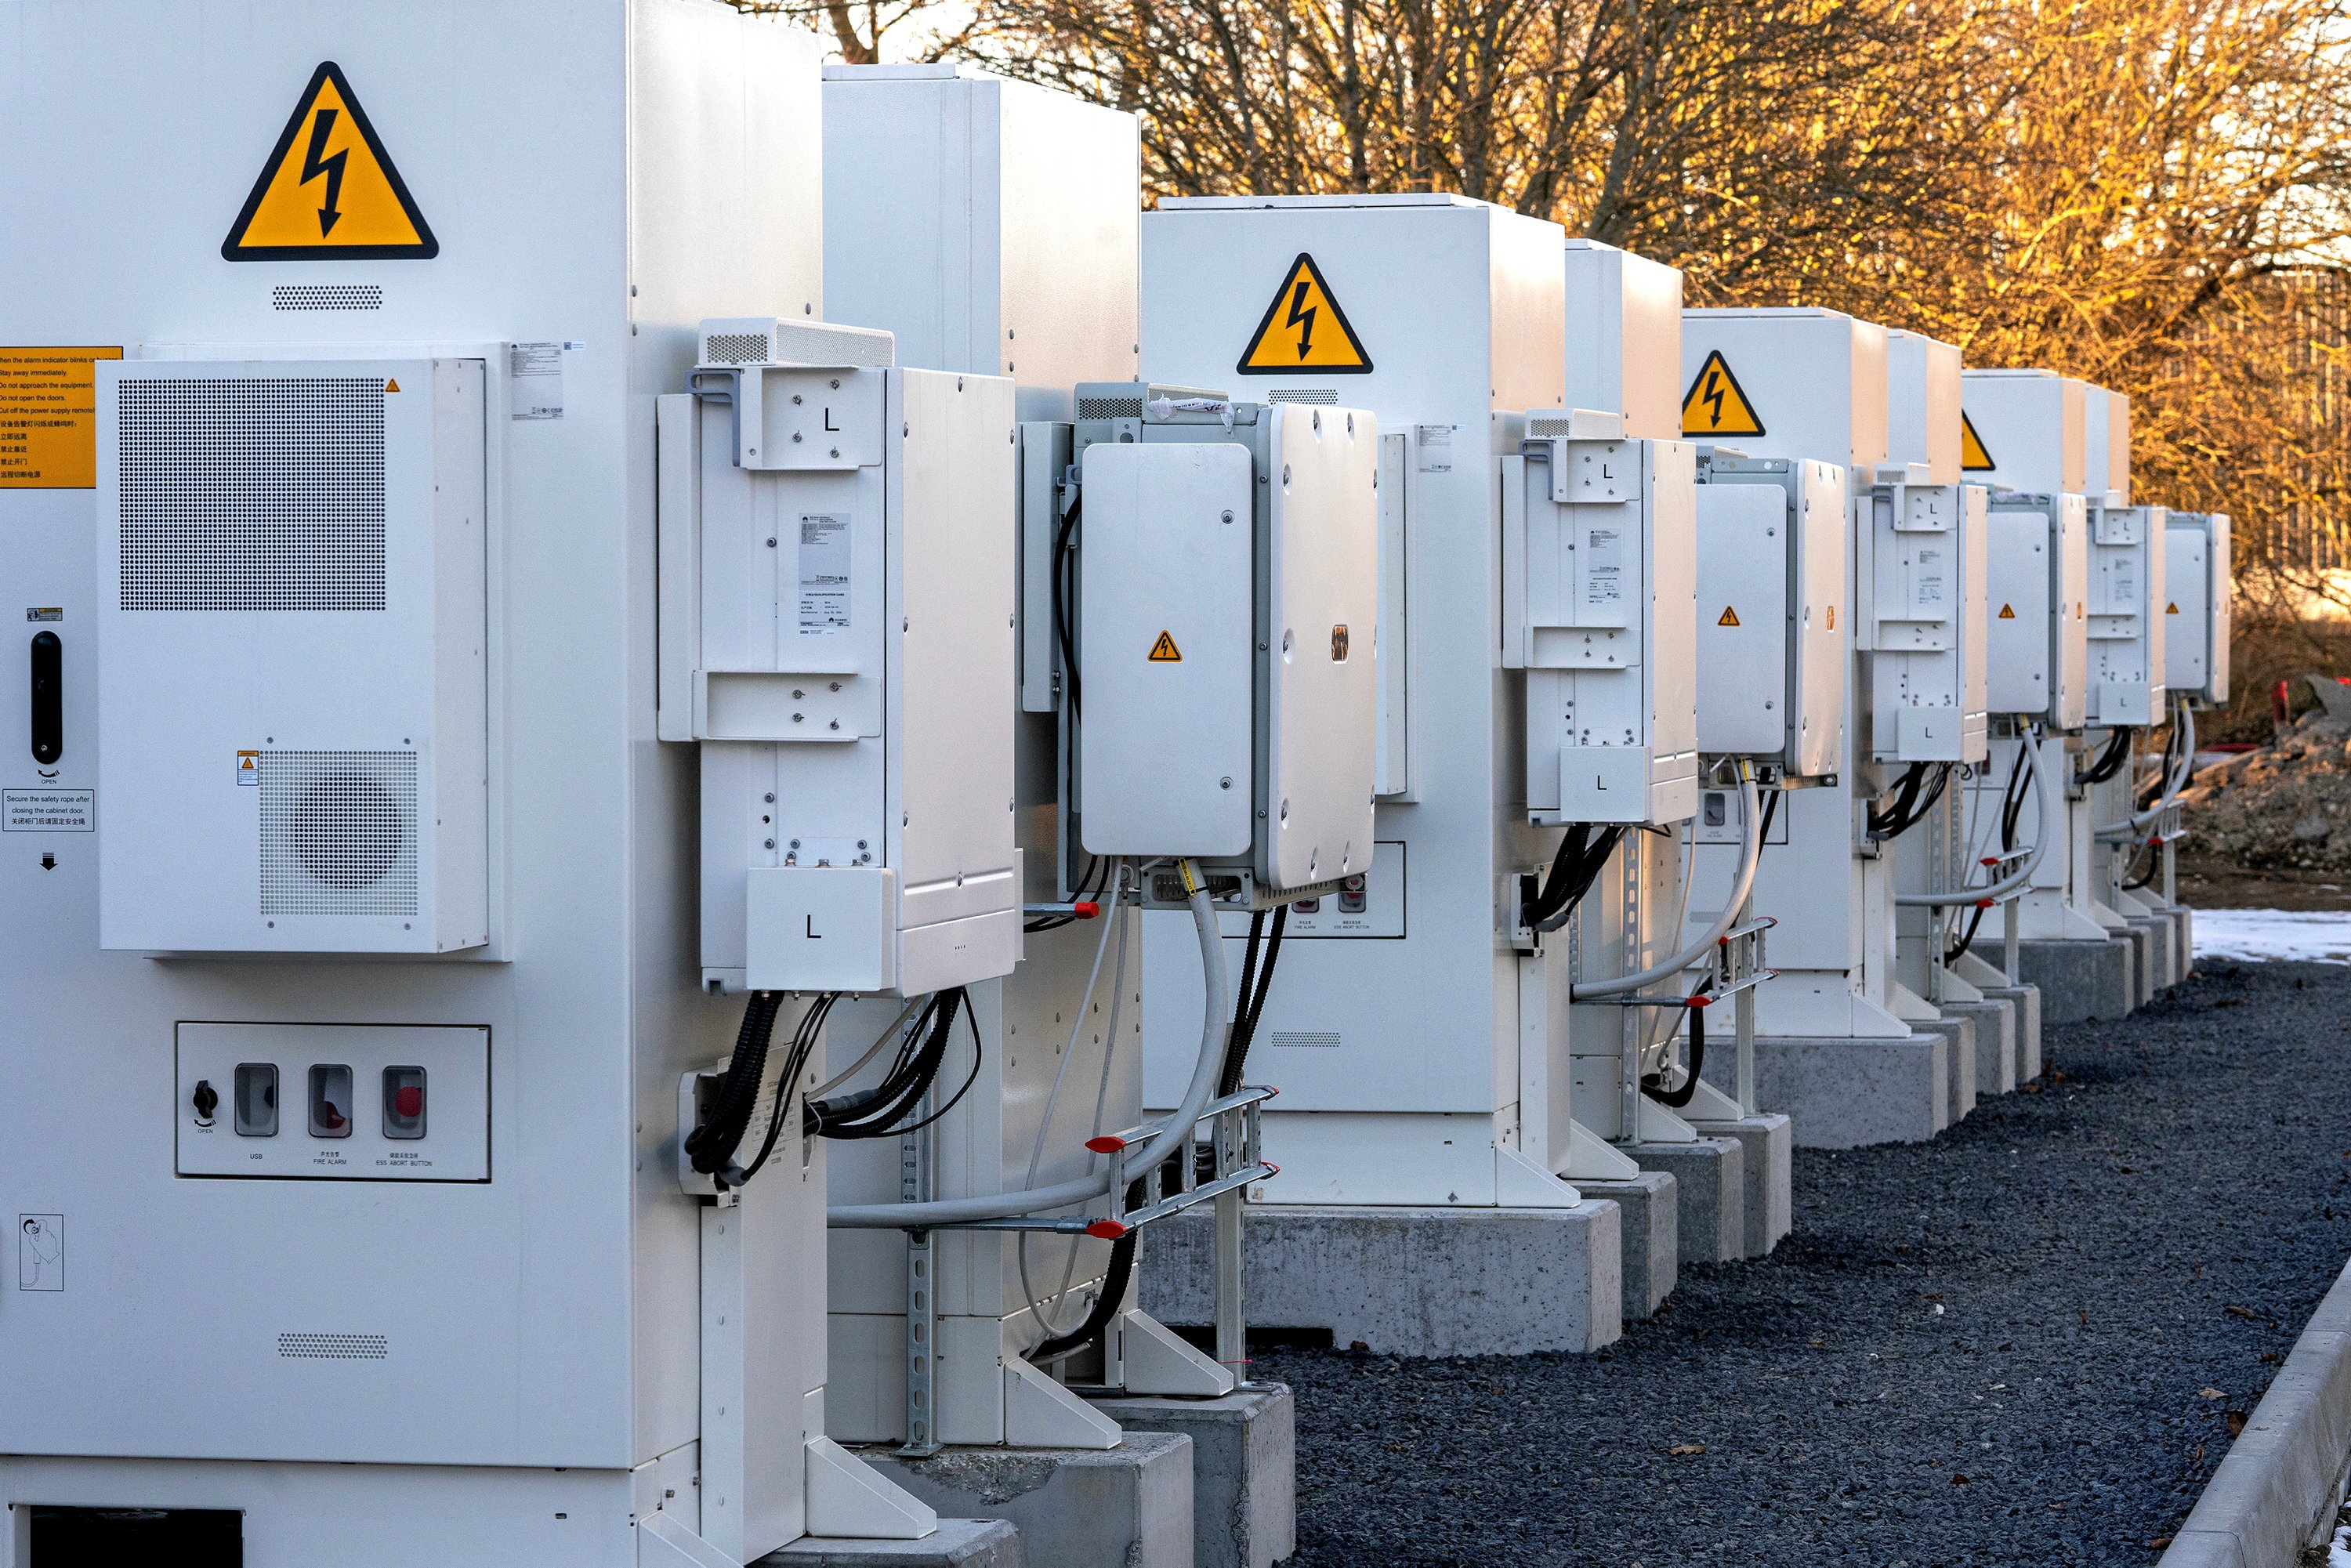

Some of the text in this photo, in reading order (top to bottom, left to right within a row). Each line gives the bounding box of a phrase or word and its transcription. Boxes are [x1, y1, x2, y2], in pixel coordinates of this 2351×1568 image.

[825, 407, 840, 431] L
[1603, 464, 1613, 479] L
[1929, 503, 1937, 515] L
[2124, 522, 2130, 531] L
[2121, 697, 2127, 707] L
[1925, 727, 1933, 739] L
[1597, 775, 1607, 790] L
[807, 914, 821, 939] L
